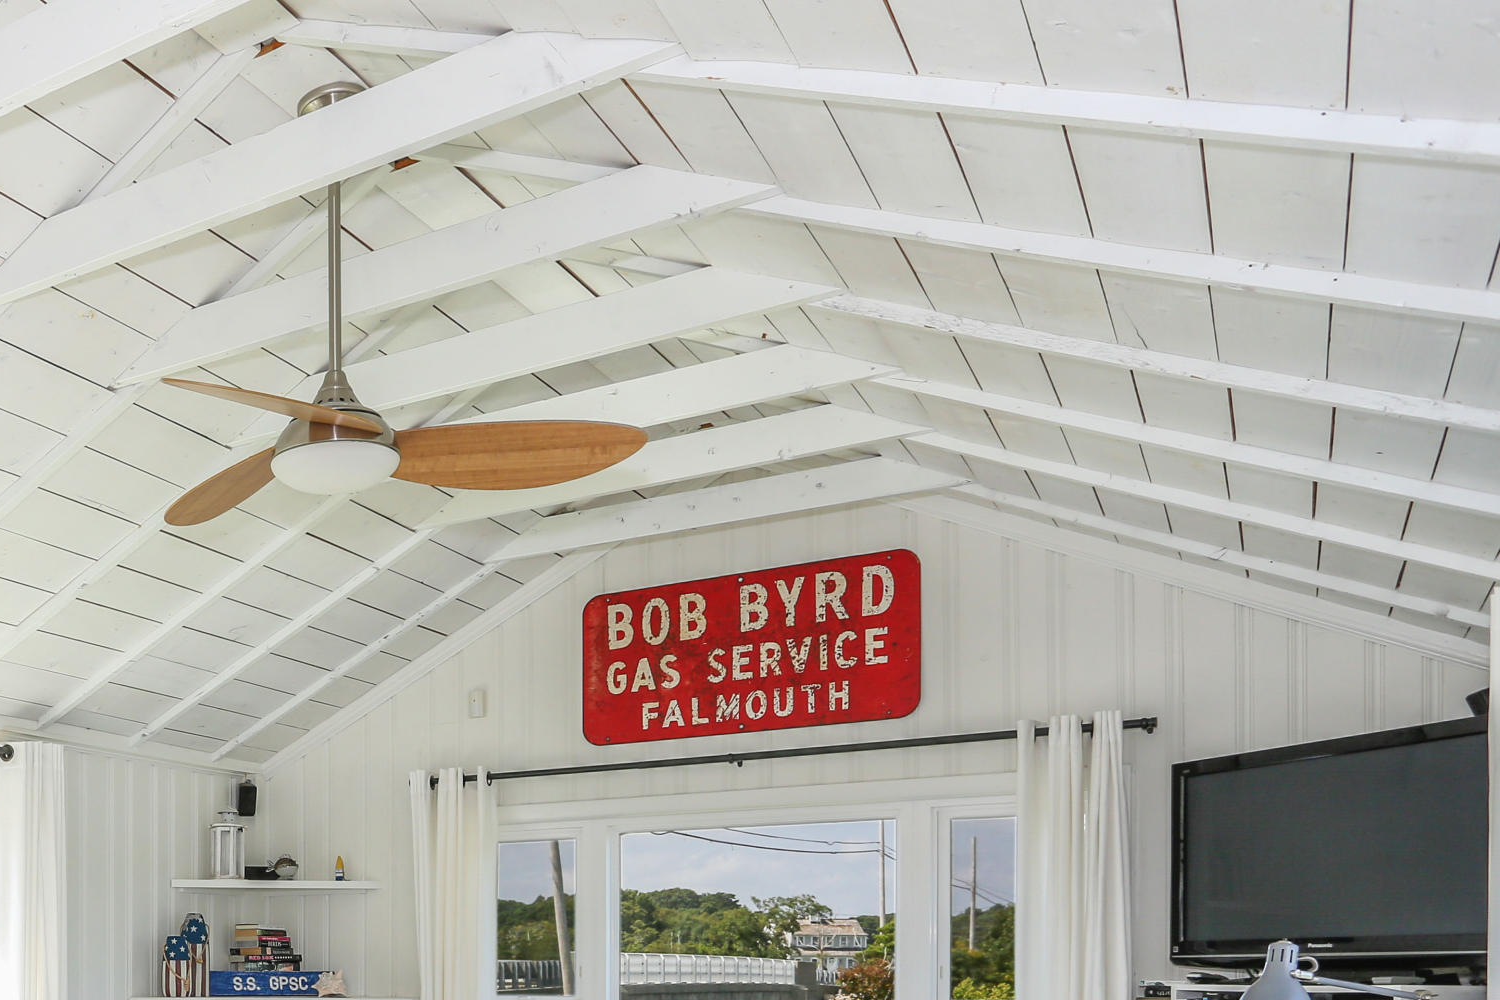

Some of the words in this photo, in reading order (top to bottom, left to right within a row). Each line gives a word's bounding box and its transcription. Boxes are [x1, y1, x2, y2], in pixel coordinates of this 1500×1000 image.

[607, 592, 708, 650] BOB
[739, 564, 896, 632] BYRD
[606, 654, 682, 695] GAS
[707, 626, 889, 684] SERVICE
[642, 680, 850, 730] FALMOUTH
[232, 976, 261, 991] S.S.
[269, 976, 309, 991] GPSC
